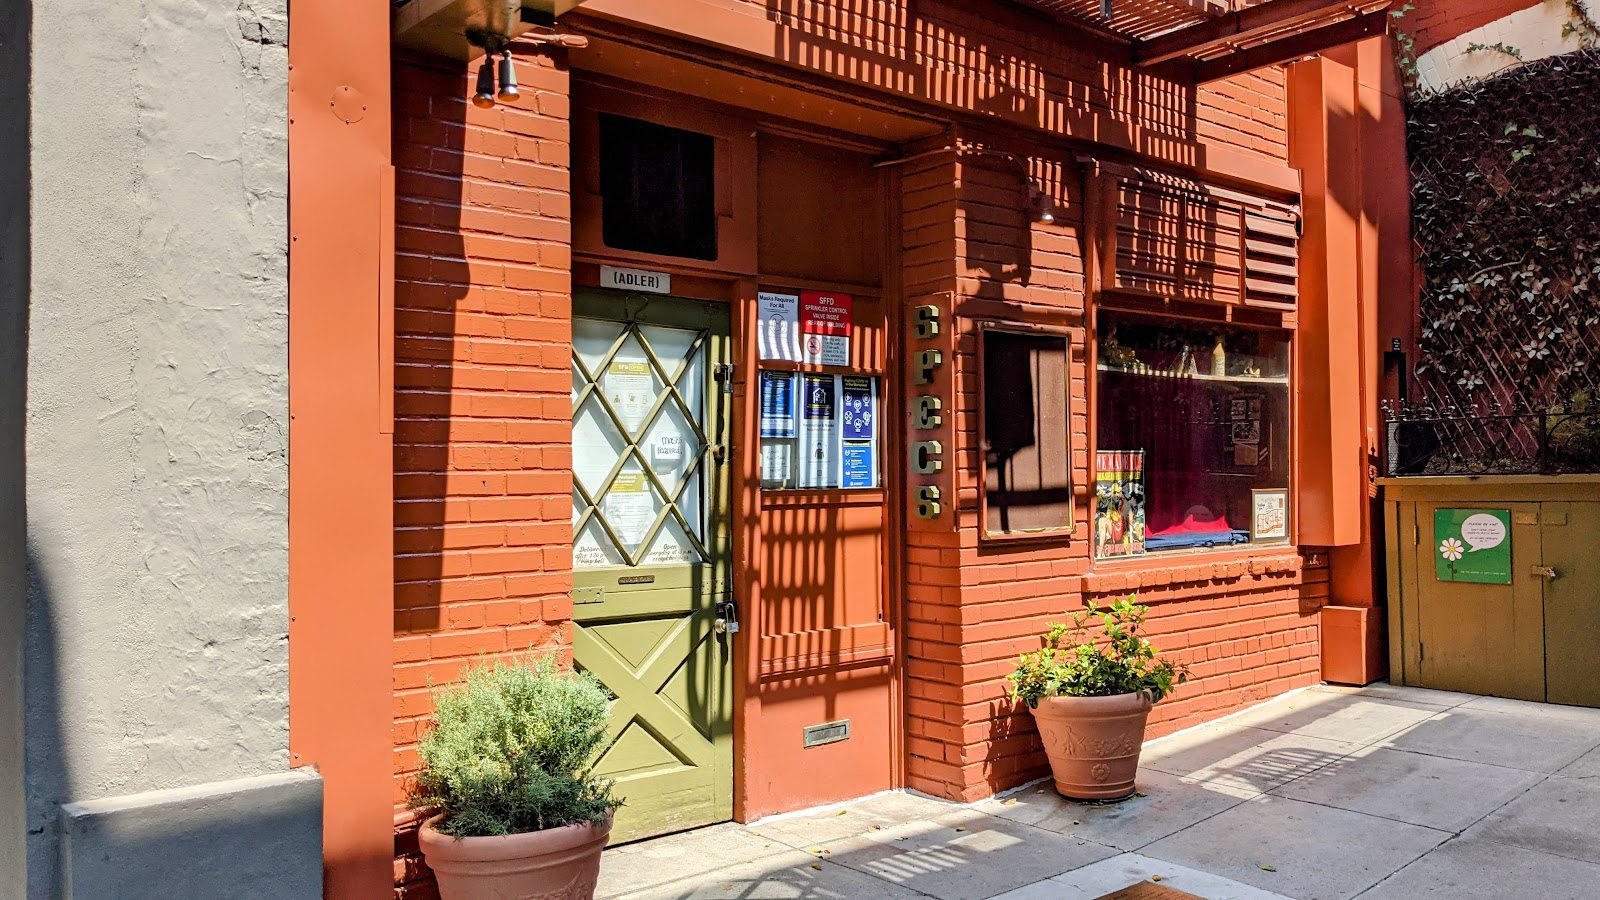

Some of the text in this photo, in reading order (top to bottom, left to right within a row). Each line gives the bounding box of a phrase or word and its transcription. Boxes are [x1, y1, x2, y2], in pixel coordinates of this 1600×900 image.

[614, 272, 659, 288] (ADLER)
[819, 297, 834, 305] SFFD
[911, 304, 942, 519] SPECS
